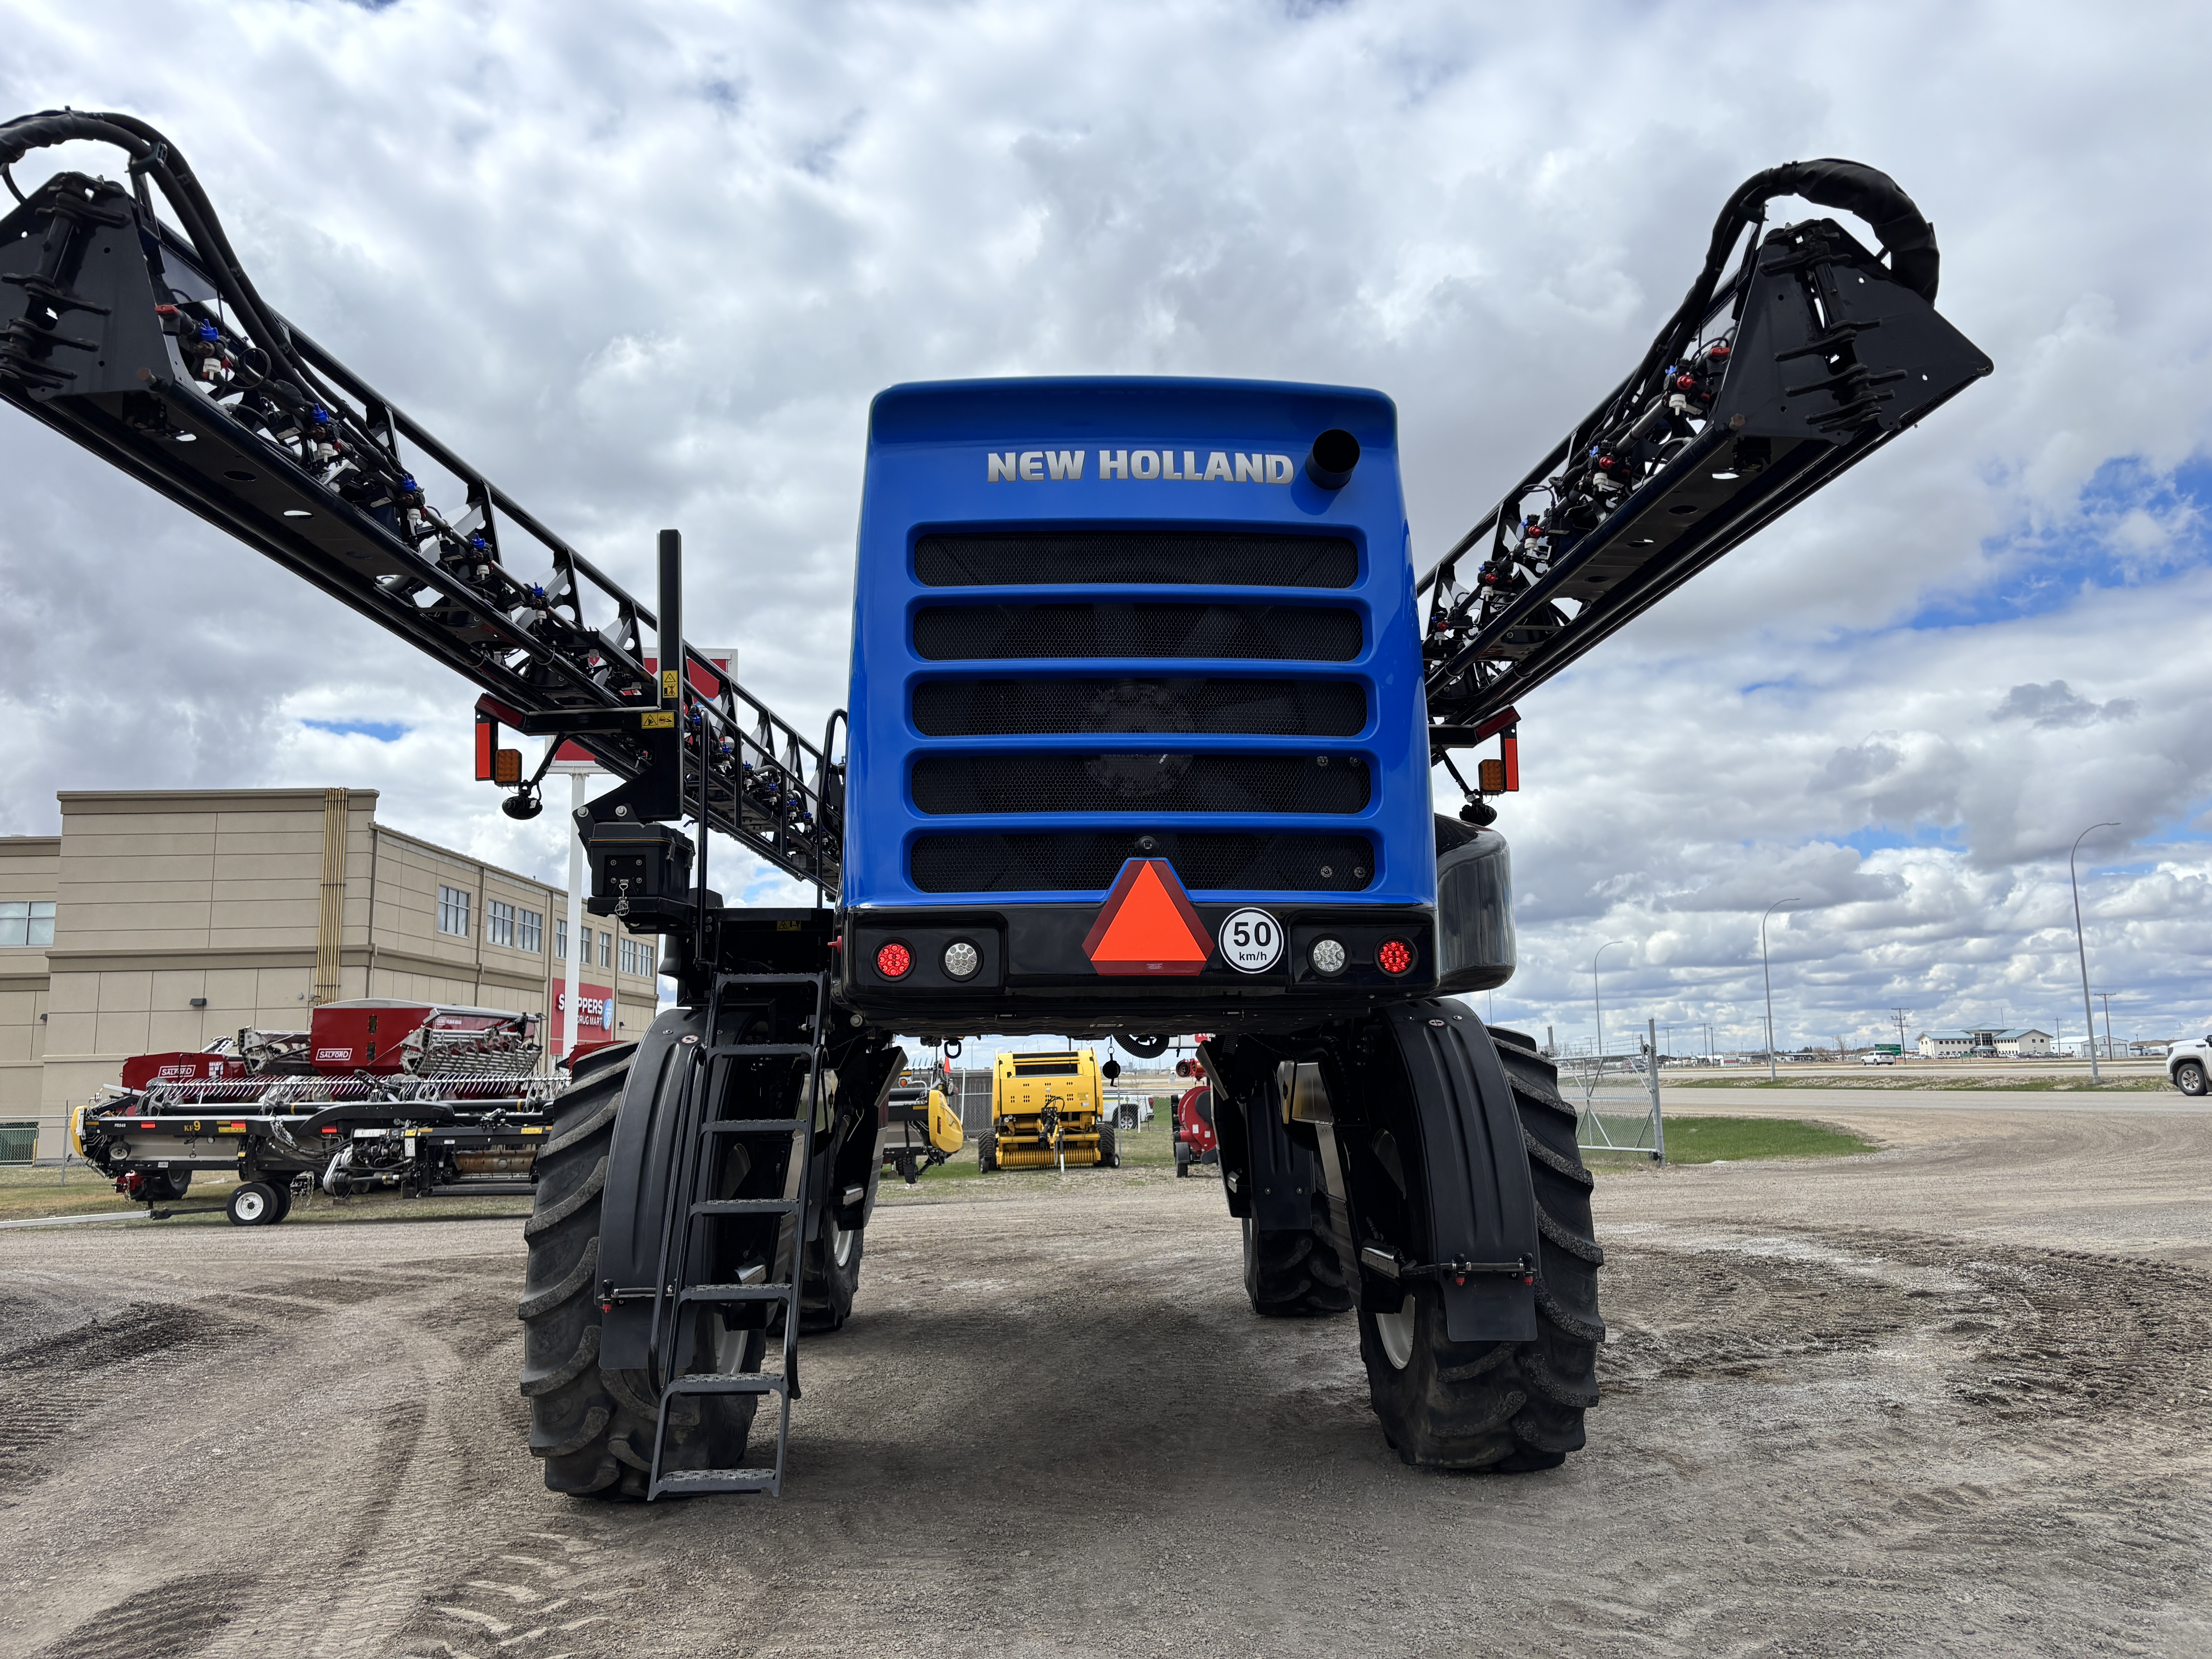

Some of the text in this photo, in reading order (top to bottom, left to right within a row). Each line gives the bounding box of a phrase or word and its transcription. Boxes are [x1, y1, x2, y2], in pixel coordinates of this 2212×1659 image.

[988, 450, 1294, 484] NEW HOLLAND
[1233, 922, 1271, 947] 50
[1239, 951, 1267, 961] km/h
[558, 993, 603, 1015] SPPERS
[589, 1016, 603, 1026] MART
